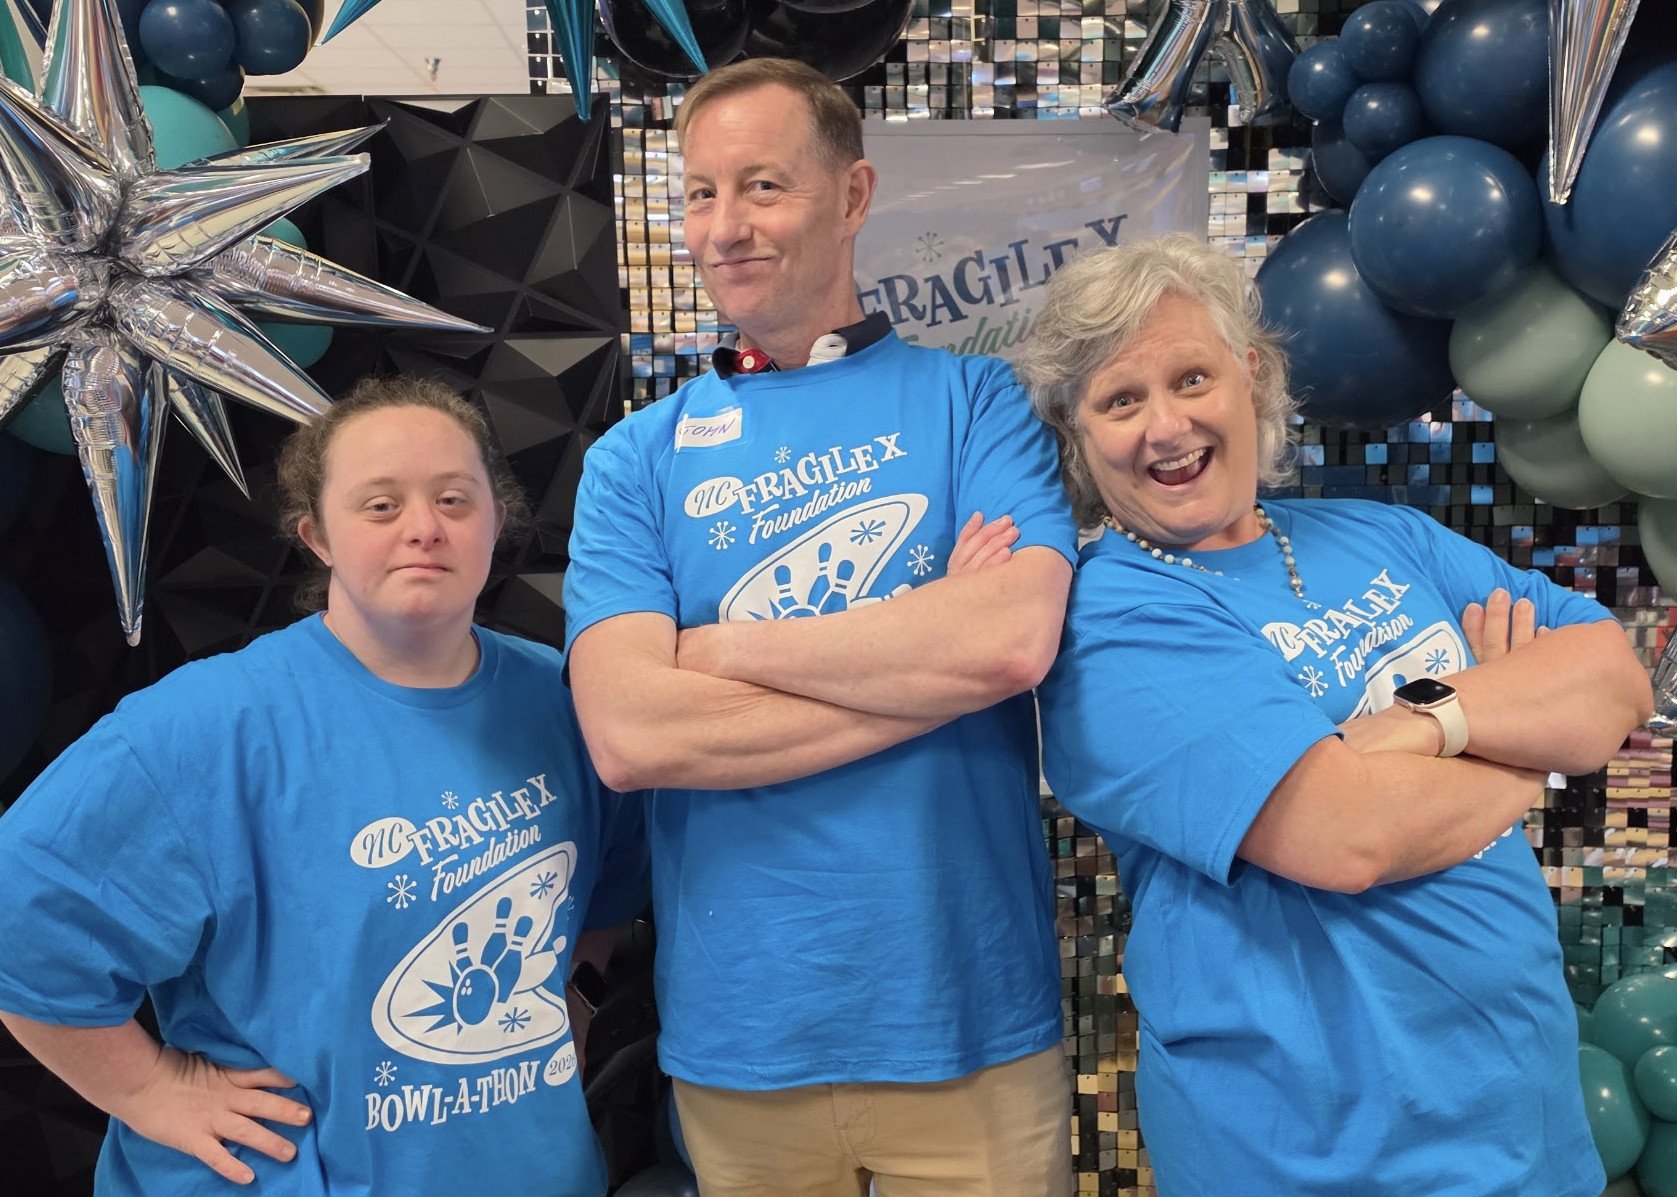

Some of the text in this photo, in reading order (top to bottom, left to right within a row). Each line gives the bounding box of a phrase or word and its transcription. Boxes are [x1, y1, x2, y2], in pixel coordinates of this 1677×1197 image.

[694, 481, 732, 516] NC
[748, 477, 872, 545] Foundation
[362, 822, 403, 865] NC
[430, 823, 542, 902] Foundation
[365, 1060, 541, 1132] BOWL-A-THON
